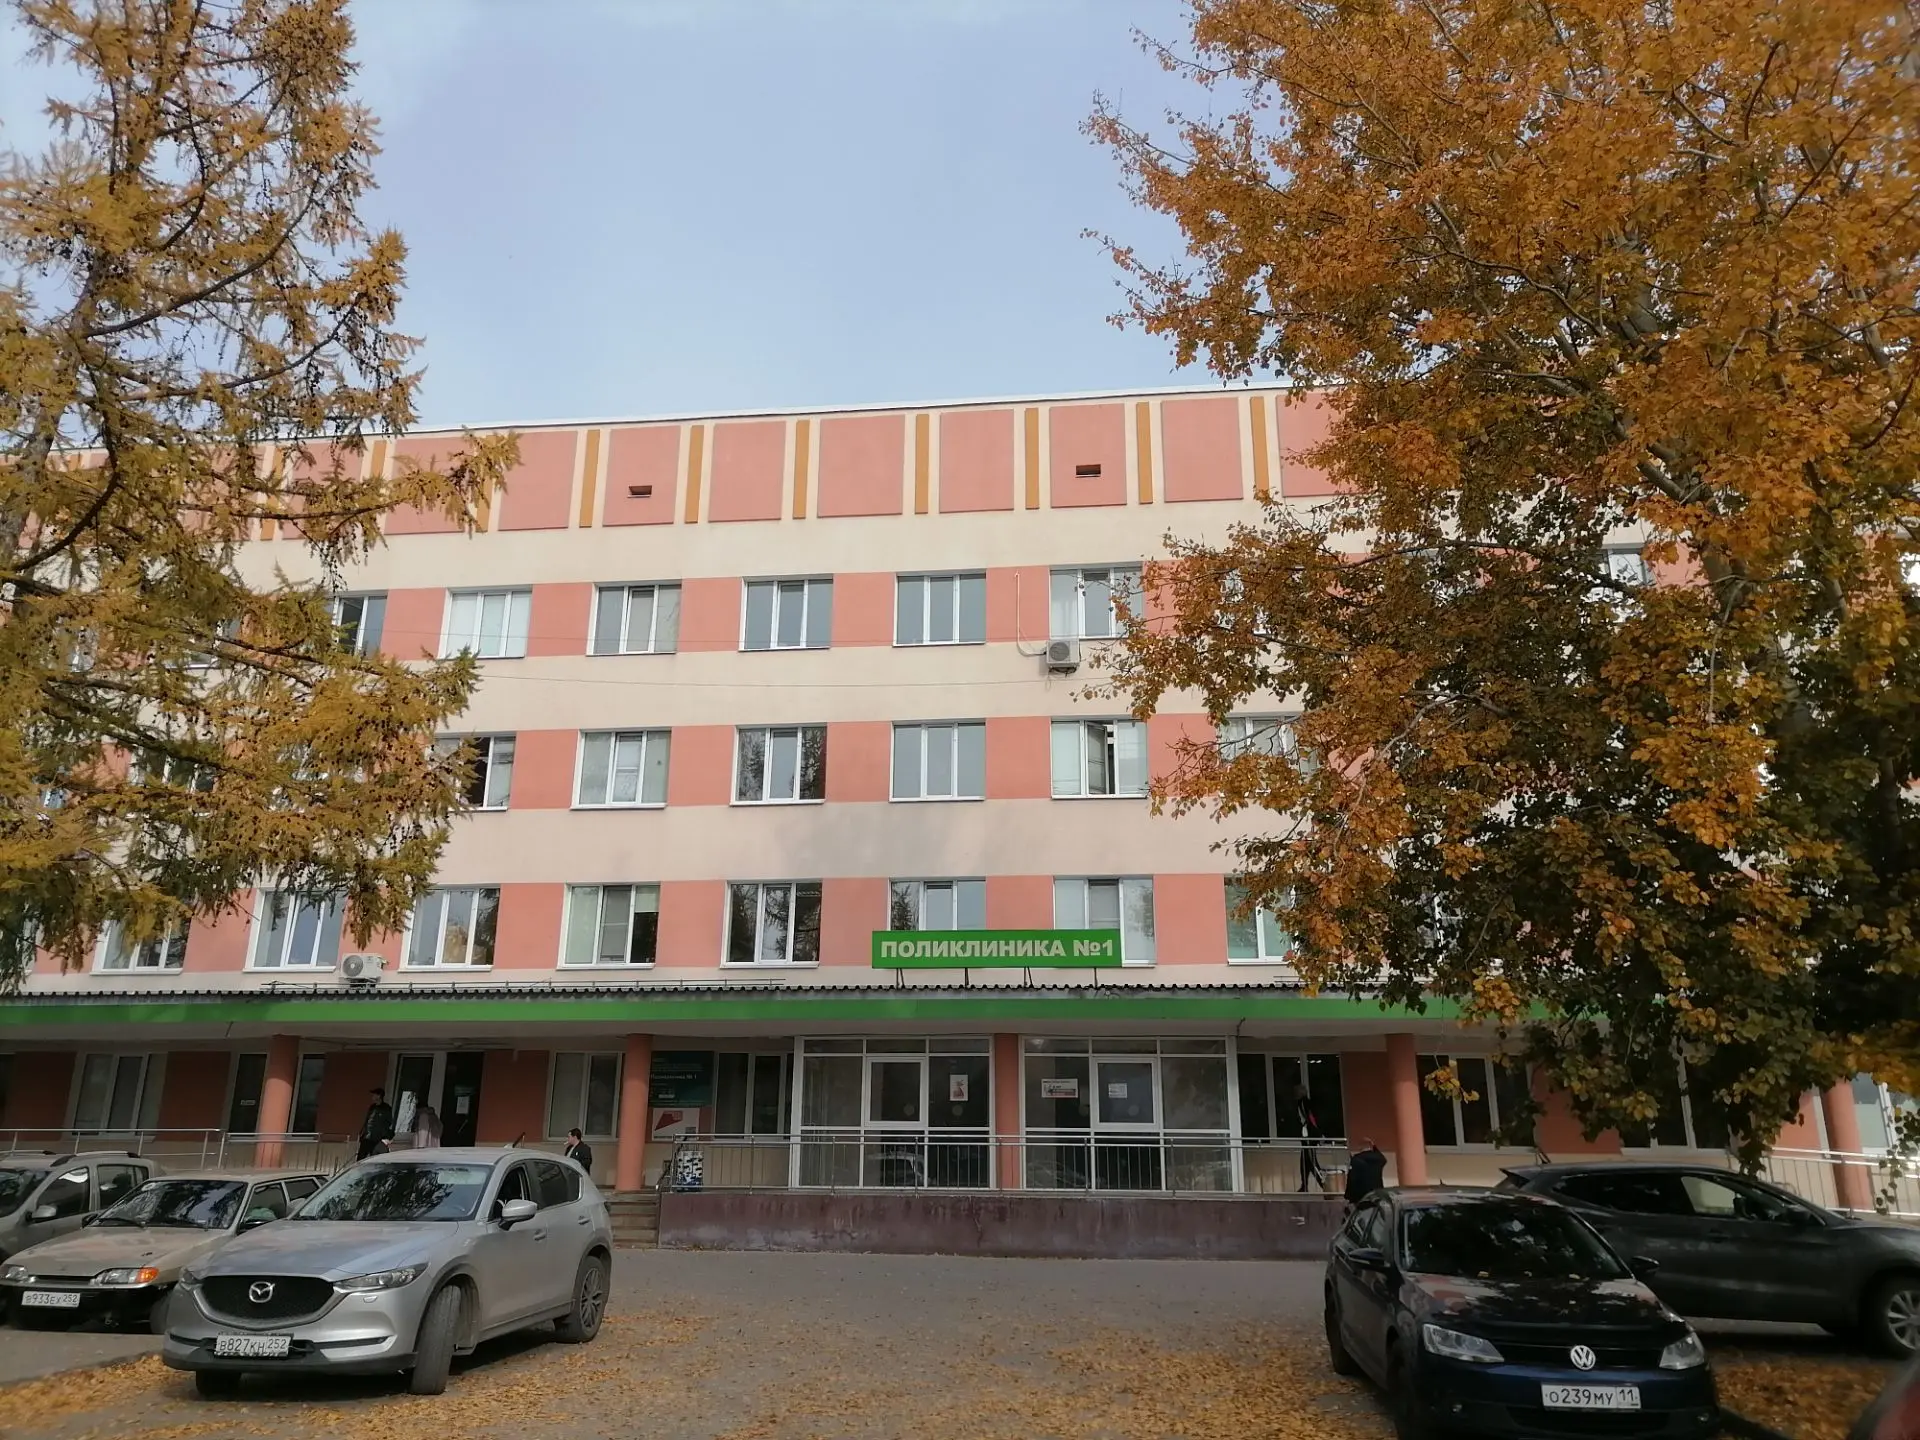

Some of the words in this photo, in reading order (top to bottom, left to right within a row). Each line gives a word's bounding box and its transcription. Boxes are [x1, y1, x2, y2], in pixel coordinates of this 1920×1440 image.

[880, 939, 1066, 958] ПОЛИКЛИНИКА
[1073, 939, 1113, 957] №1
[220, 1338, 265, 1353] В827КН
[268, 1338, 287, 1350] 252
[1549, 1388, 1613, 1405] О239МУ
[1619, 1389, 1634, 1401] 11
